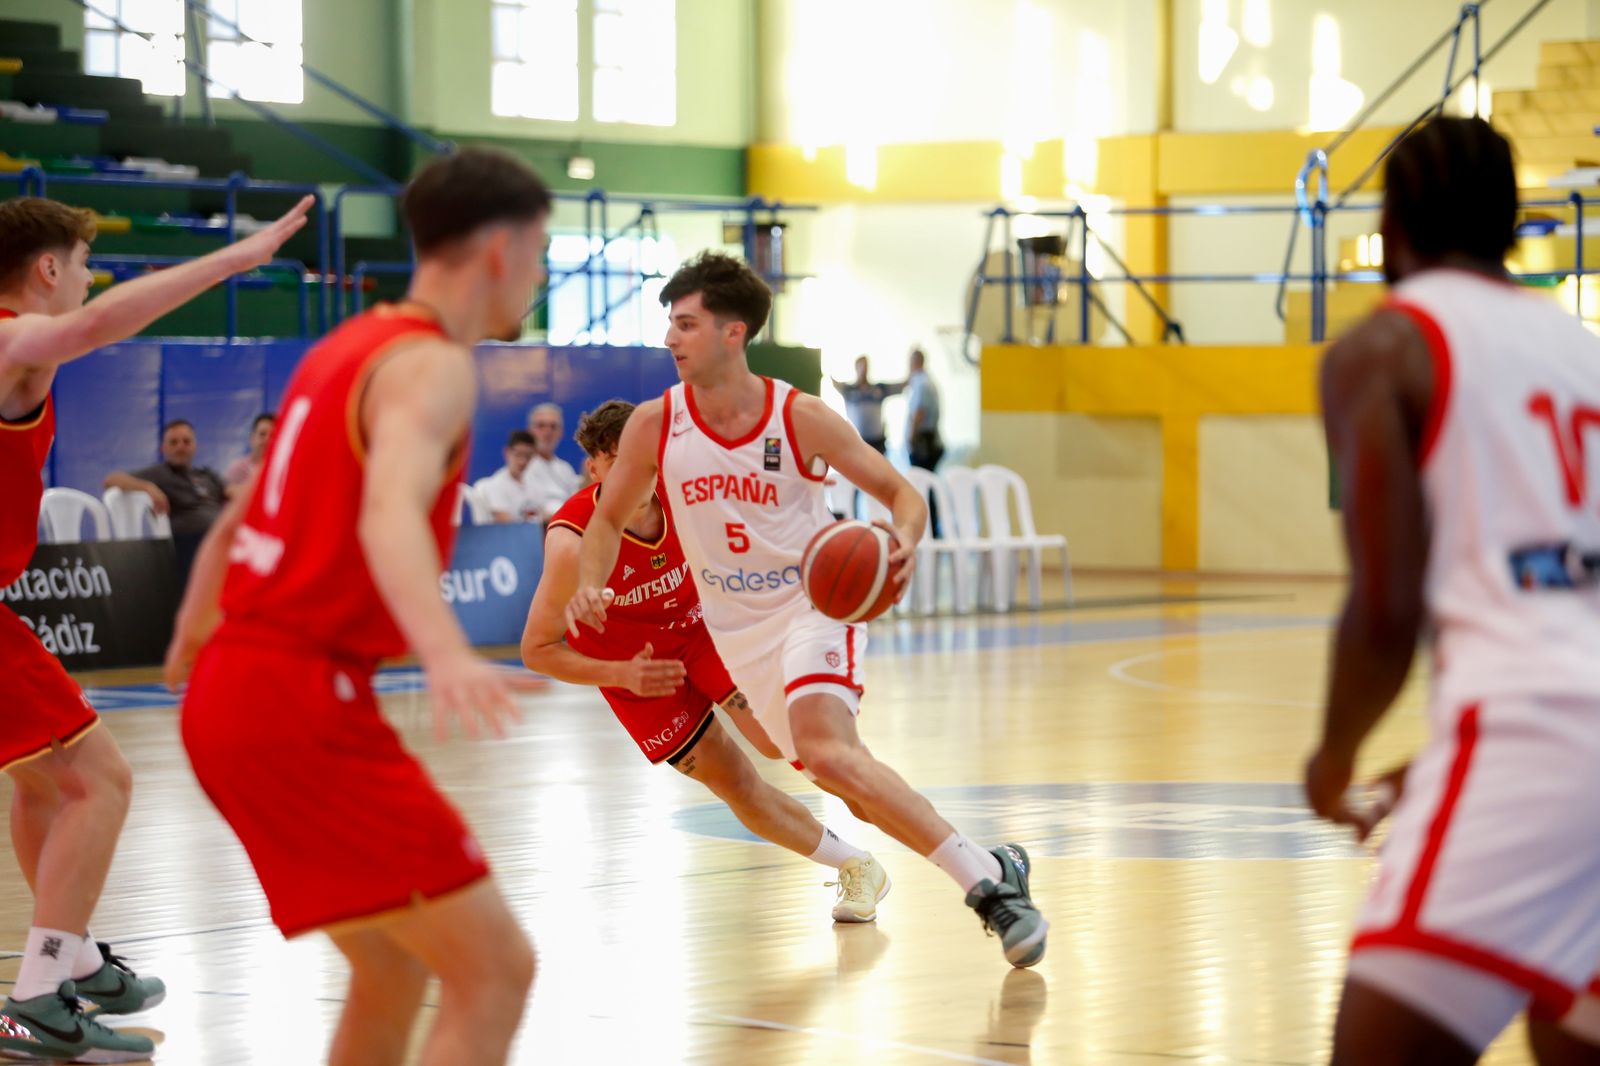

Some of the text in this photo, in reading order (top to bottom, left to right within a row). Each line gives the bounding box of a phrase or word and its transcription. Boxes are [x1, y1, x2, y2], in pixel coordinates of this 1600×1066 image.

[681, 473, 779, 507] ESPAÑA
[725, 522, 751, 554] 5
[0, 557, 112, 600] utación
[642, 728, 674, 752] ING
